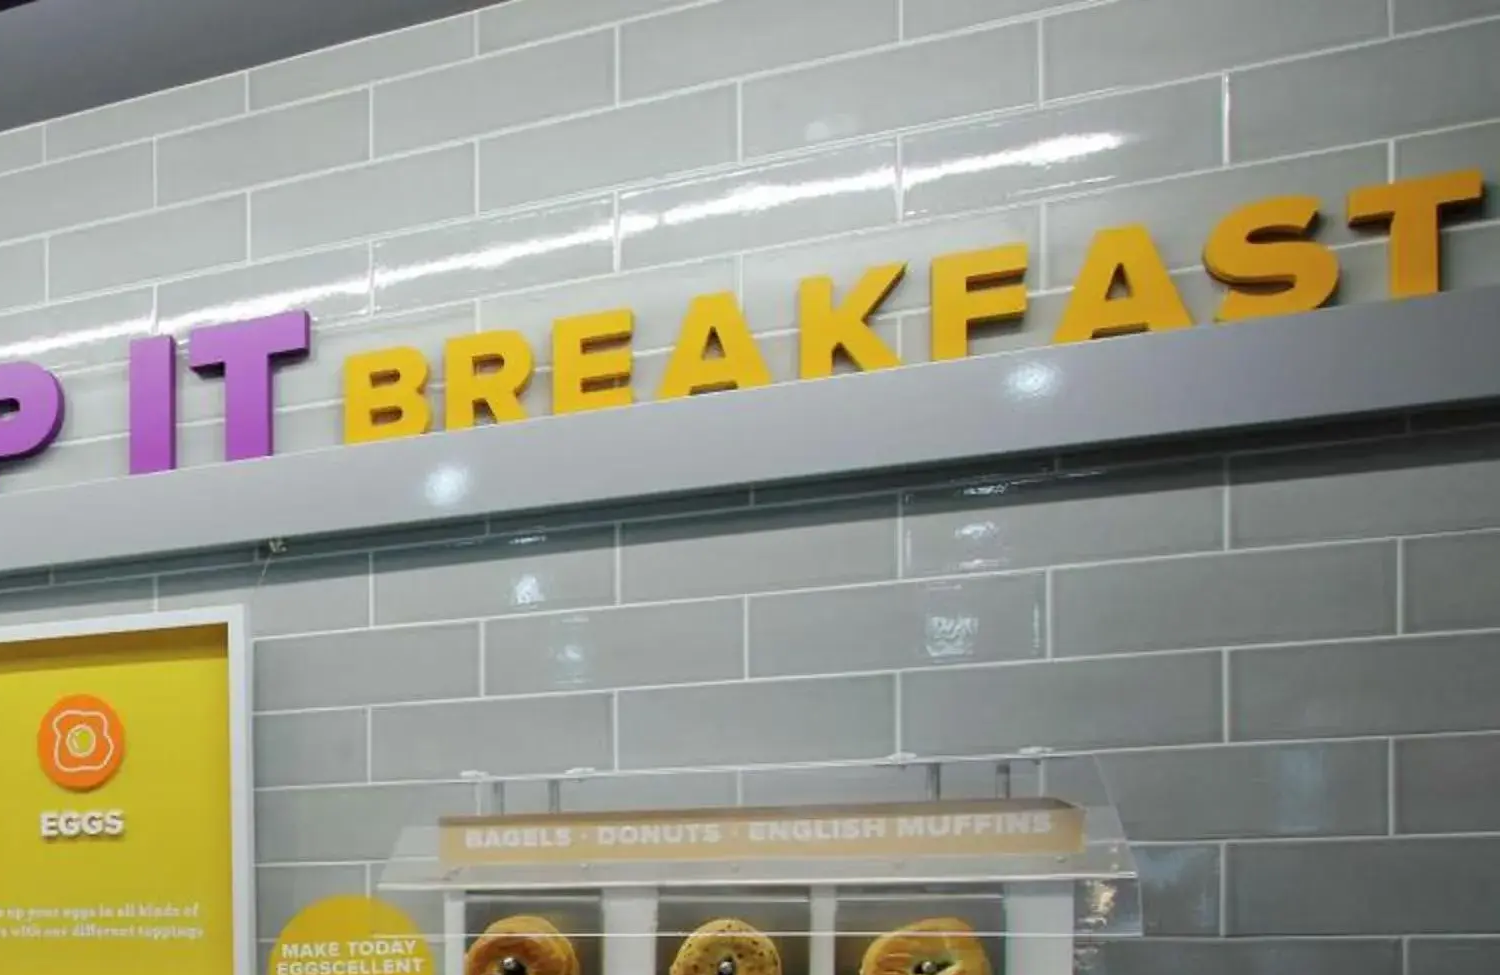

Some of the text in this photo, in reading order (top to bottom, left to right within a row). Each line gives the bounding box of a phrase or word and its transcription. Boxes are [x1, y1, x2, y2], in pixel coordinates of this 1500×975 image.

[128, 309, 310, 475] IT
[342, 167, 1485, 445] BREAKFAST
[40, 810, 126, 839] EGGS
[465, 811, 1052, 849] BAGELS DONUTS ENGLISH MUFFINS
[62, 908, 96, 921] eggs
[117, 903, 136, 917] all
[140, 903, 180, 917] kinds
[183, 903, 199, 917] of
[72, 923, 134, 937] different
[138, 925, 205, 940] toppings
[281, 940, 417, 958] MAKE TODAY
